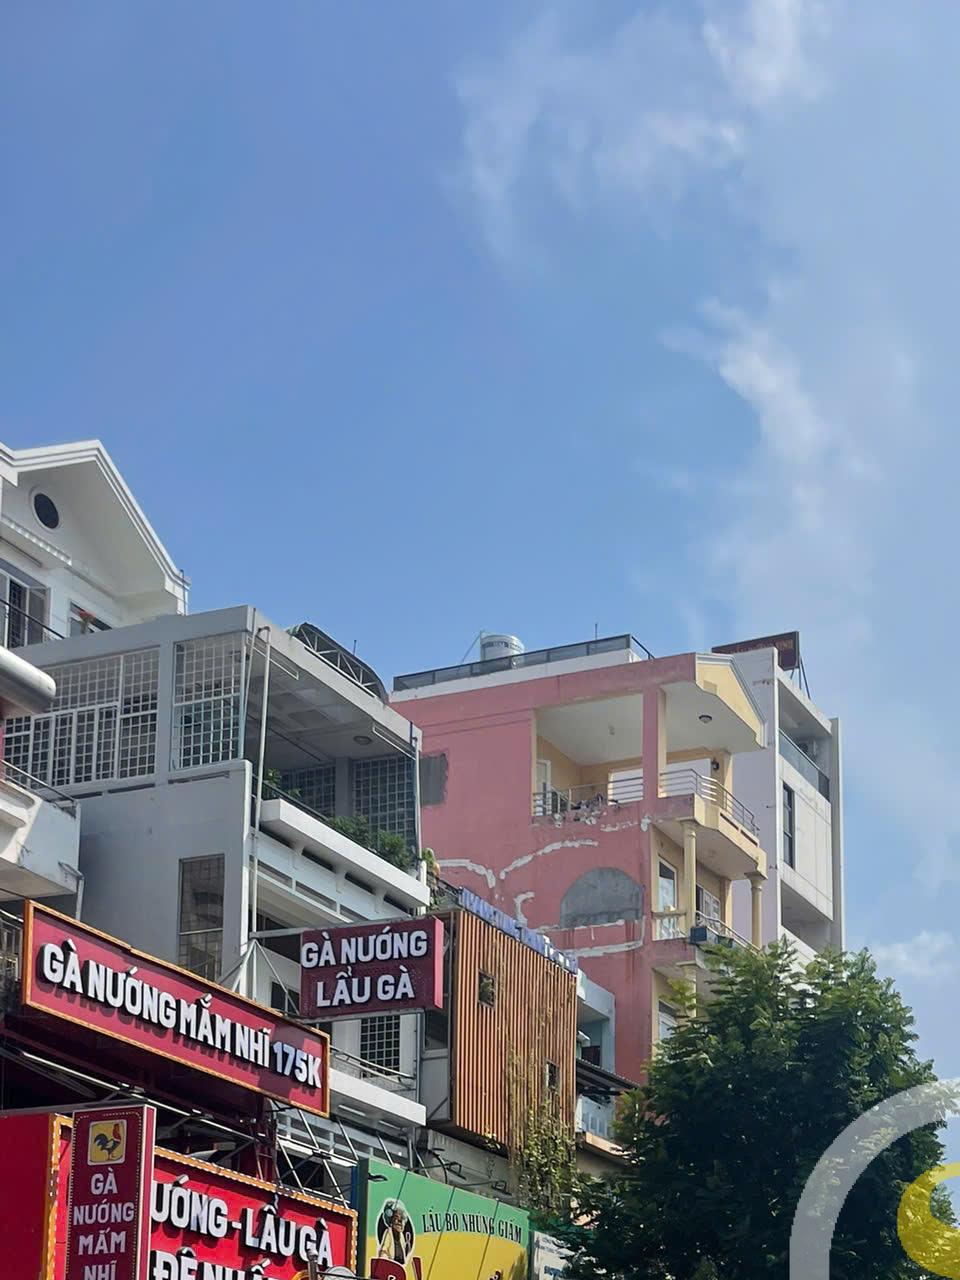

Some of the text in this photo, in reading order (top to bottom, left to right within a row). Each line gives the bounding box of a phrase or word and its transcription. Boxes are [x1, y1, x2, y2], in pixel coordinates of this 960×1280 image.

[301, 926, 427, 968] GÀ NƯỚNG
[317, 965, 415, 1007] LẨU GÀ
[43, 939, 83, 993] GÀ
[86, 967, 176, 1028] NƯỚNG
[180, 993, 232, 1053] MẮM
[272, 1041, 321, 1089] 175K
[90, 1168, 118, 1195] GÀ
[73, 1199, 135, 1226] NƯỚNG
[151, 1174, 228, 1238] ƯỚNG
[245, 1193, 296, 1256] LẨU
[299, 1217, 333, 1267] GÀ
